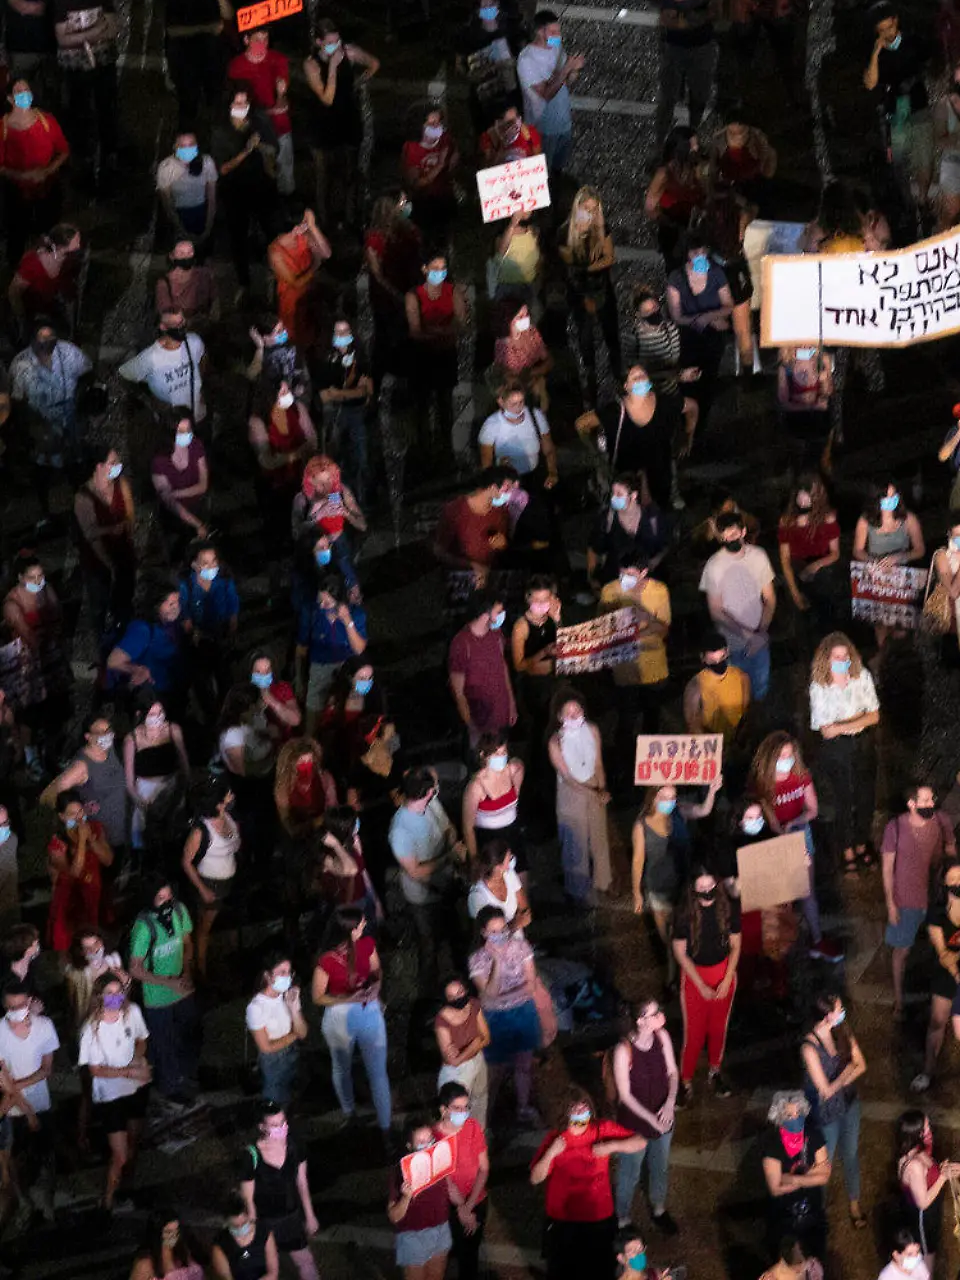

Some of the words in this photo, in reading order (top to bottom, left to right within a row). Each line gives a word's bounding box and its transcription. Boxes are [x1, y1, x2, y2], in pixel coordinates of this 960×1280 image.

[915, 242, 959, 274] אנס
[858, 260, 898, 285] לא
[825, 306, 878, 327] אחד
